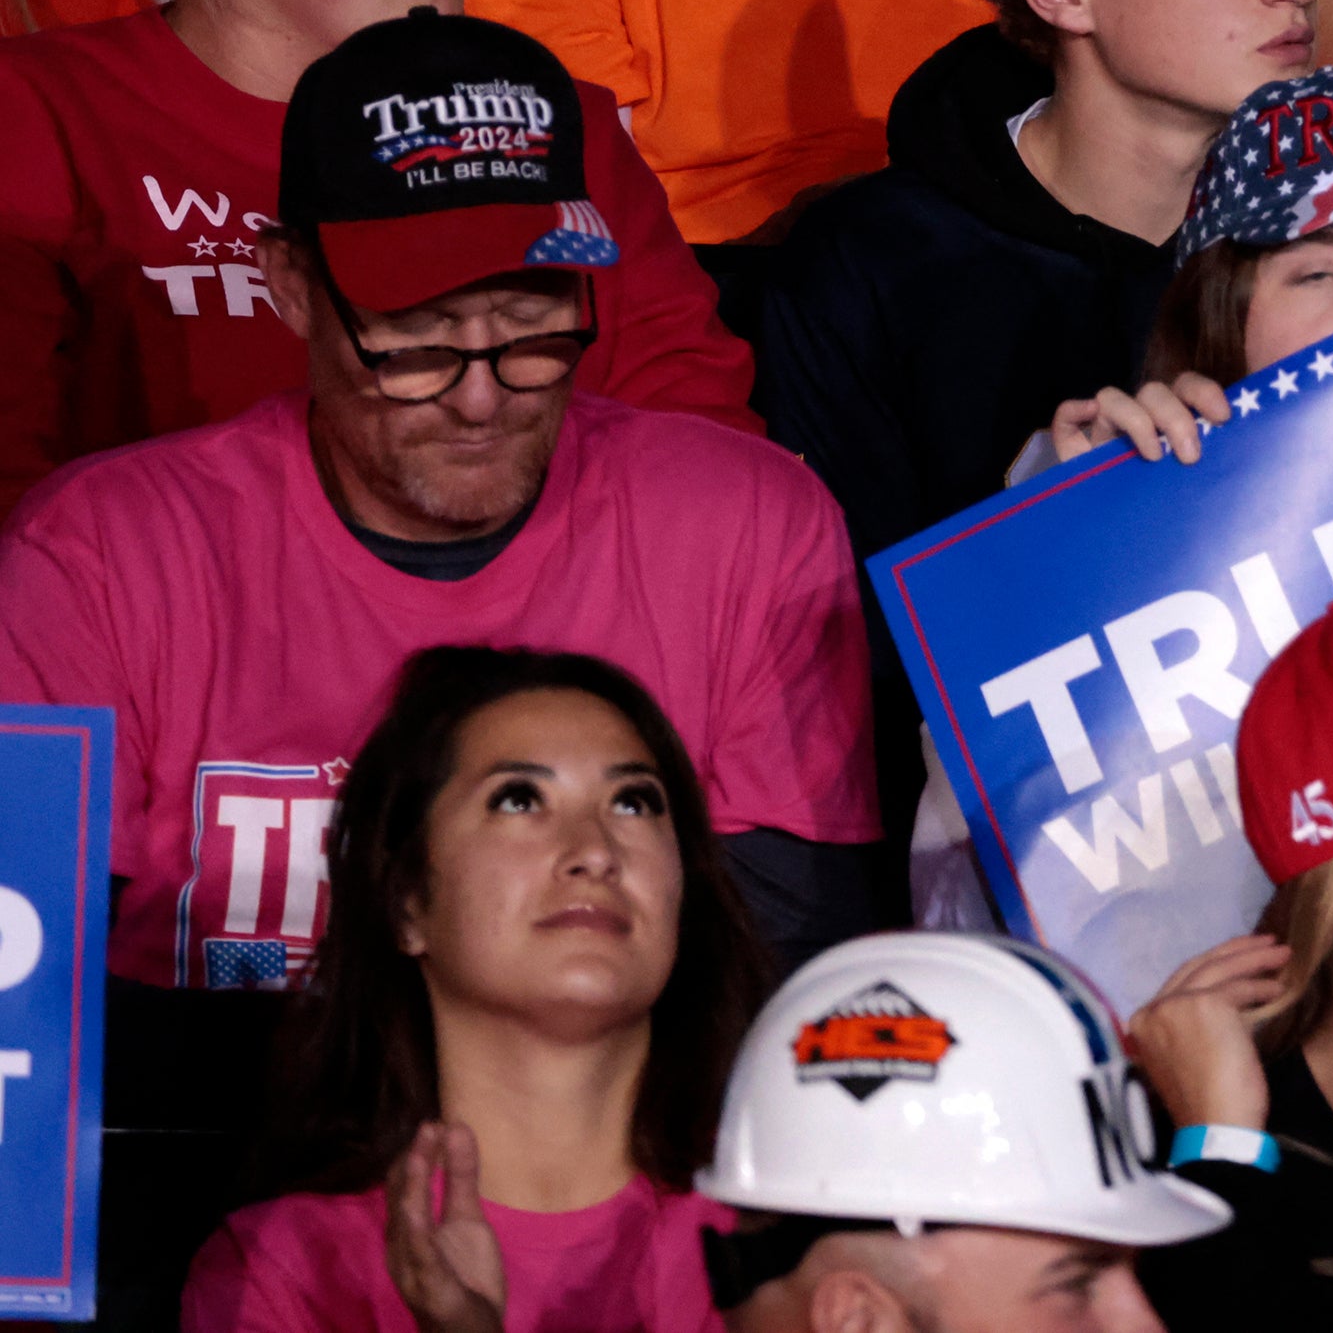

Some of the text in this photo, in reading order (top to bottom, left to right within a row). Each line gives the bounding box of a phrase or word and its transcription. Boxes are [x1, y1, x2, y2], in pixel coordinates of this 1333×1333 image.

[362, 90, 555, 143] Trump
[458, 125, 531, 154] 2024
[406, 168, 447, 190] I'LL
[453, 161, 485, 180] BE
